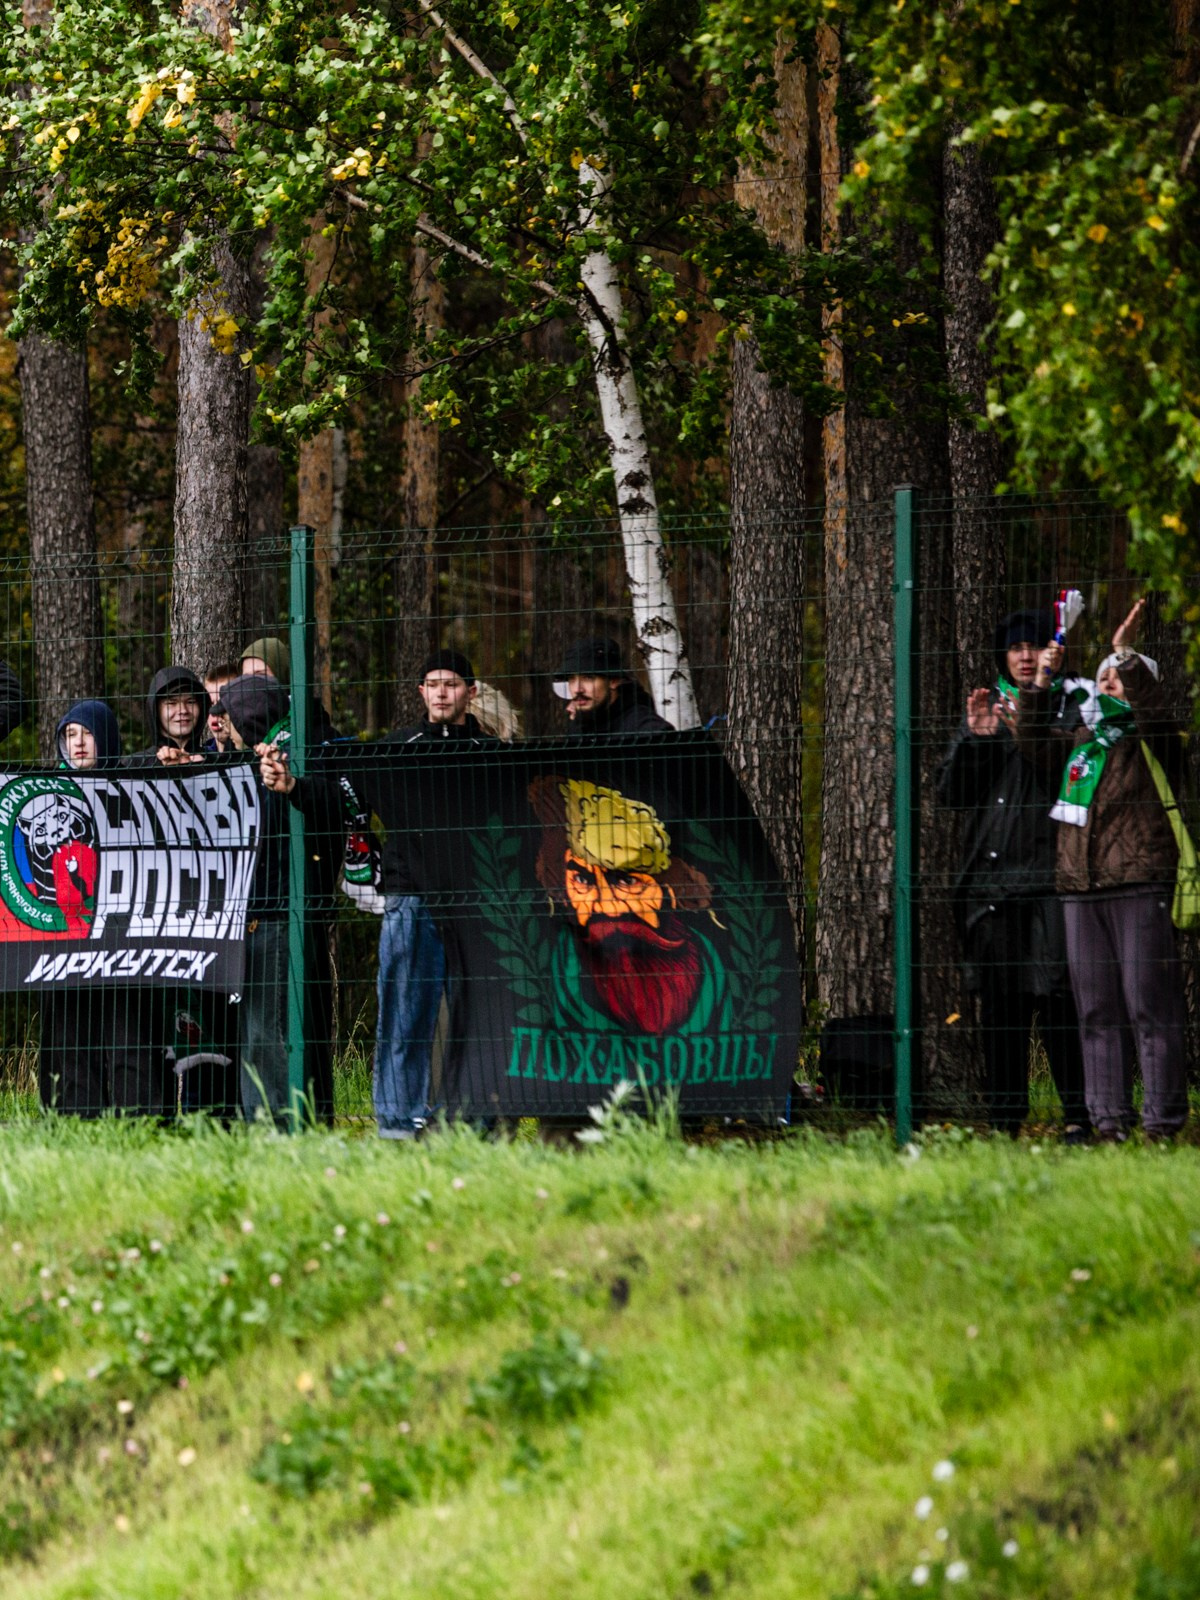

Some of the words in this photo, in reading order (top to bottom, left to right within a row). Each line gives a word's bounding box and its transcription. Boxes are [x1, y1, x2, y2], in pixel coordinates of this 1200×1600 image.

[82, 765, 260, 847] СЛАВА
[23, 948, 218, 983] ИРКУТСК
[504, 1026, 778, 1088] ПОХАБОВЦЫ
